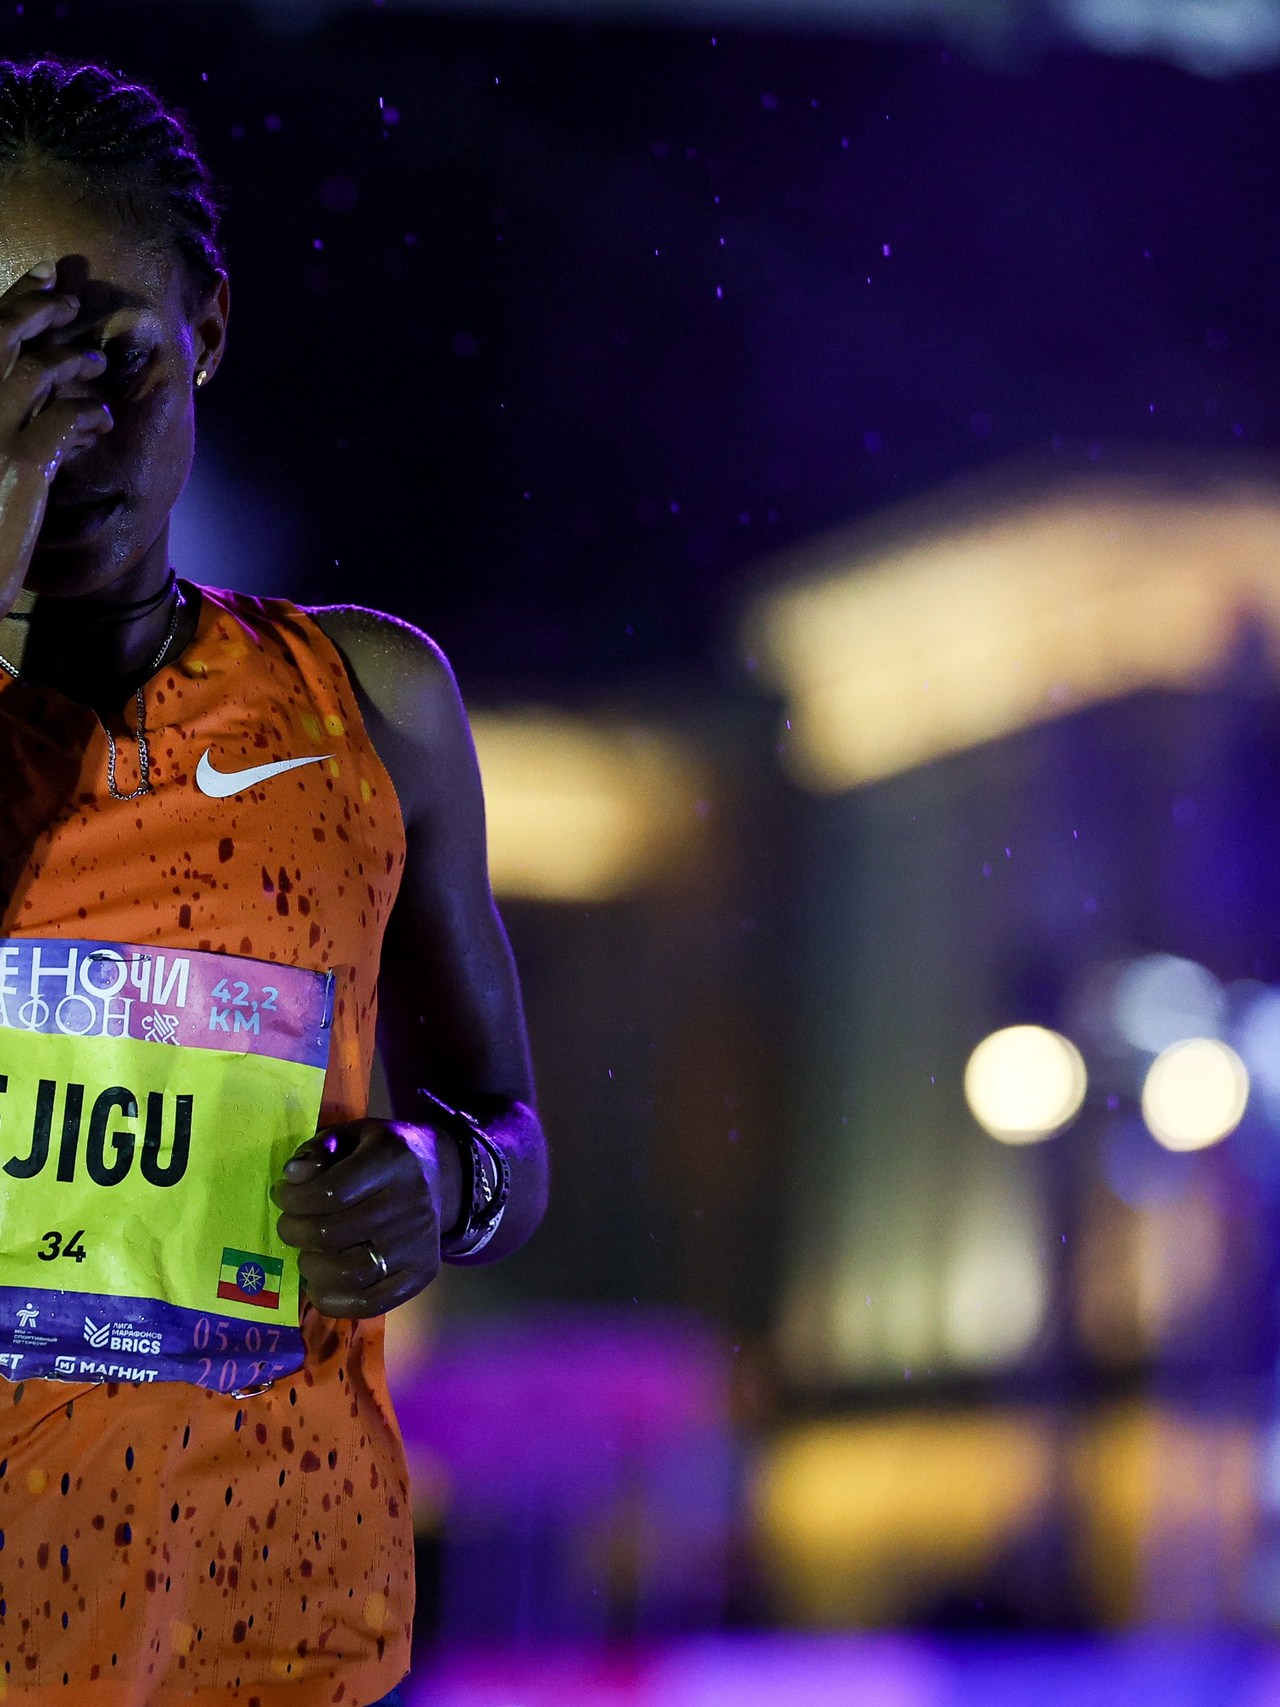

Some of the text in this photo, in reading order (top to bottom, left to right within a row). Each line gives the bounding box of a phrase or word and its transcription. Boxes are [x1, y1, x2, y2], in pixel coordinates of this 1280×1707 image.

[31, 946, 191, 1009] НОЧИ
[211, 978, 280, 1012] 42,2
[36, 1229, 88, 1264] 34
[110, 1337, 162, 1355] BRICS
[193, 1317, 282, 1353] 05.07
[79, 1360, 159, 1383] МАГНИТ
